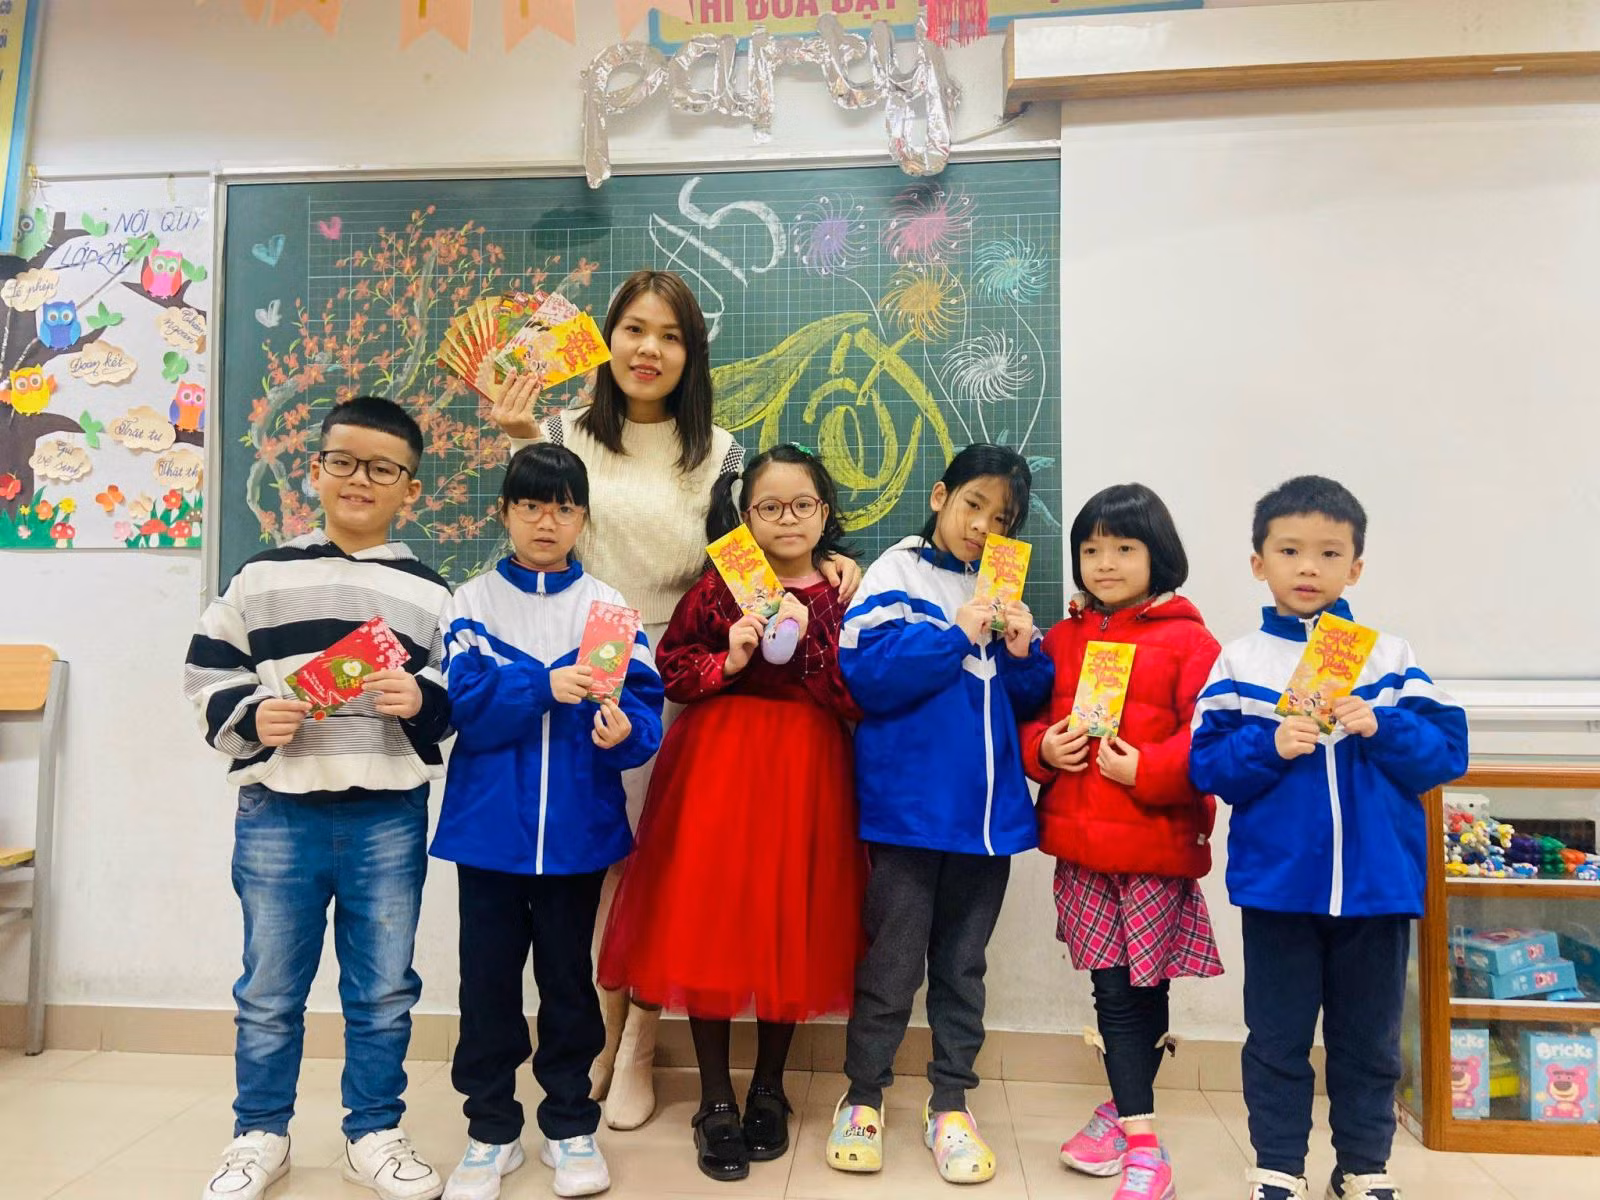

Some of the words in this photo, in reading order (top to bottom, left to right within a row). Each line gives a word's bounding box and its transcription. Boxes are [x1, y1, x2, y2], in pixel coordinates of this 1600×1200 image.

[685, 0, 734, 24] HI
[580, 13, 962, 189] party
[114, 208, 150, 236] NỘI
[1535, 1042, 1594, 1059] Bricks
